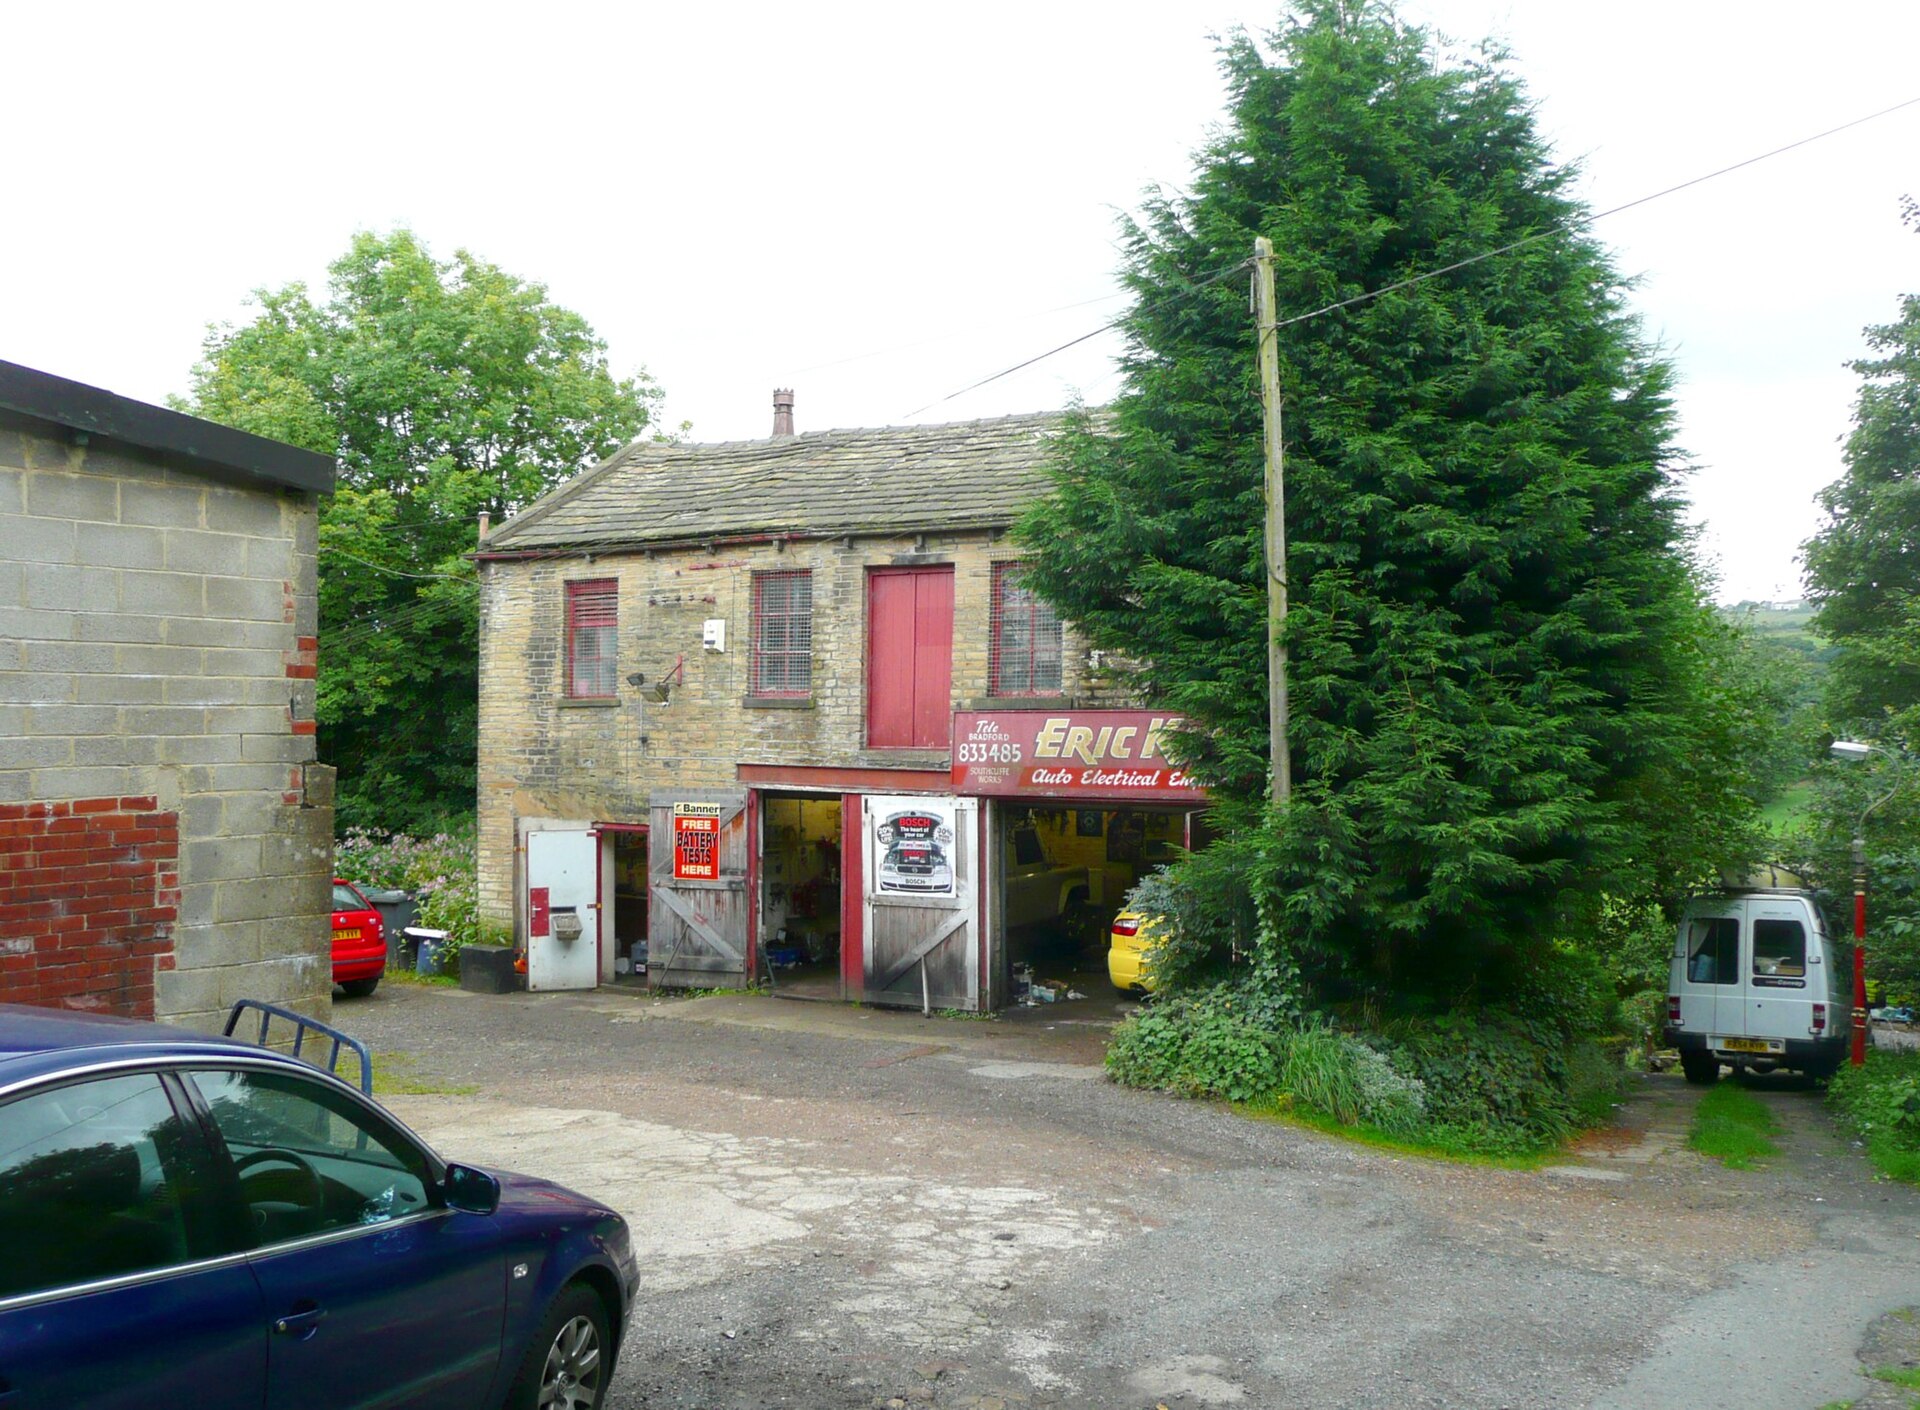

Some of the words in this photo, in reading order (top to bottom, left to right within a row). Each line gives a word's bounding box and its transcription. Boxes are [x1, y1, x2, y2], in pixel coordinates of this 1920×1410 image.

[976, 720, 999, 733] Tele
[968, 733, 1010, 741] BRADFORD
[1034, 718, 1138, 765] ERIC
[958, 743, 1022, 763] 833485
[977, 775, 1002, 784] WORKS
[1032, 768, 1074, 785] Auto
[1080, 769, 1161, 787] Electrical
[683, 803, 719, 813] Banner
[682, 819, 712, 830] FREE
[899, 817, 932, 828] BOSCH
[676, 831, 718, 848] BATTERY
[682, 848, 712, 864] TESTS
[681, 865, 712, 876] HERE
